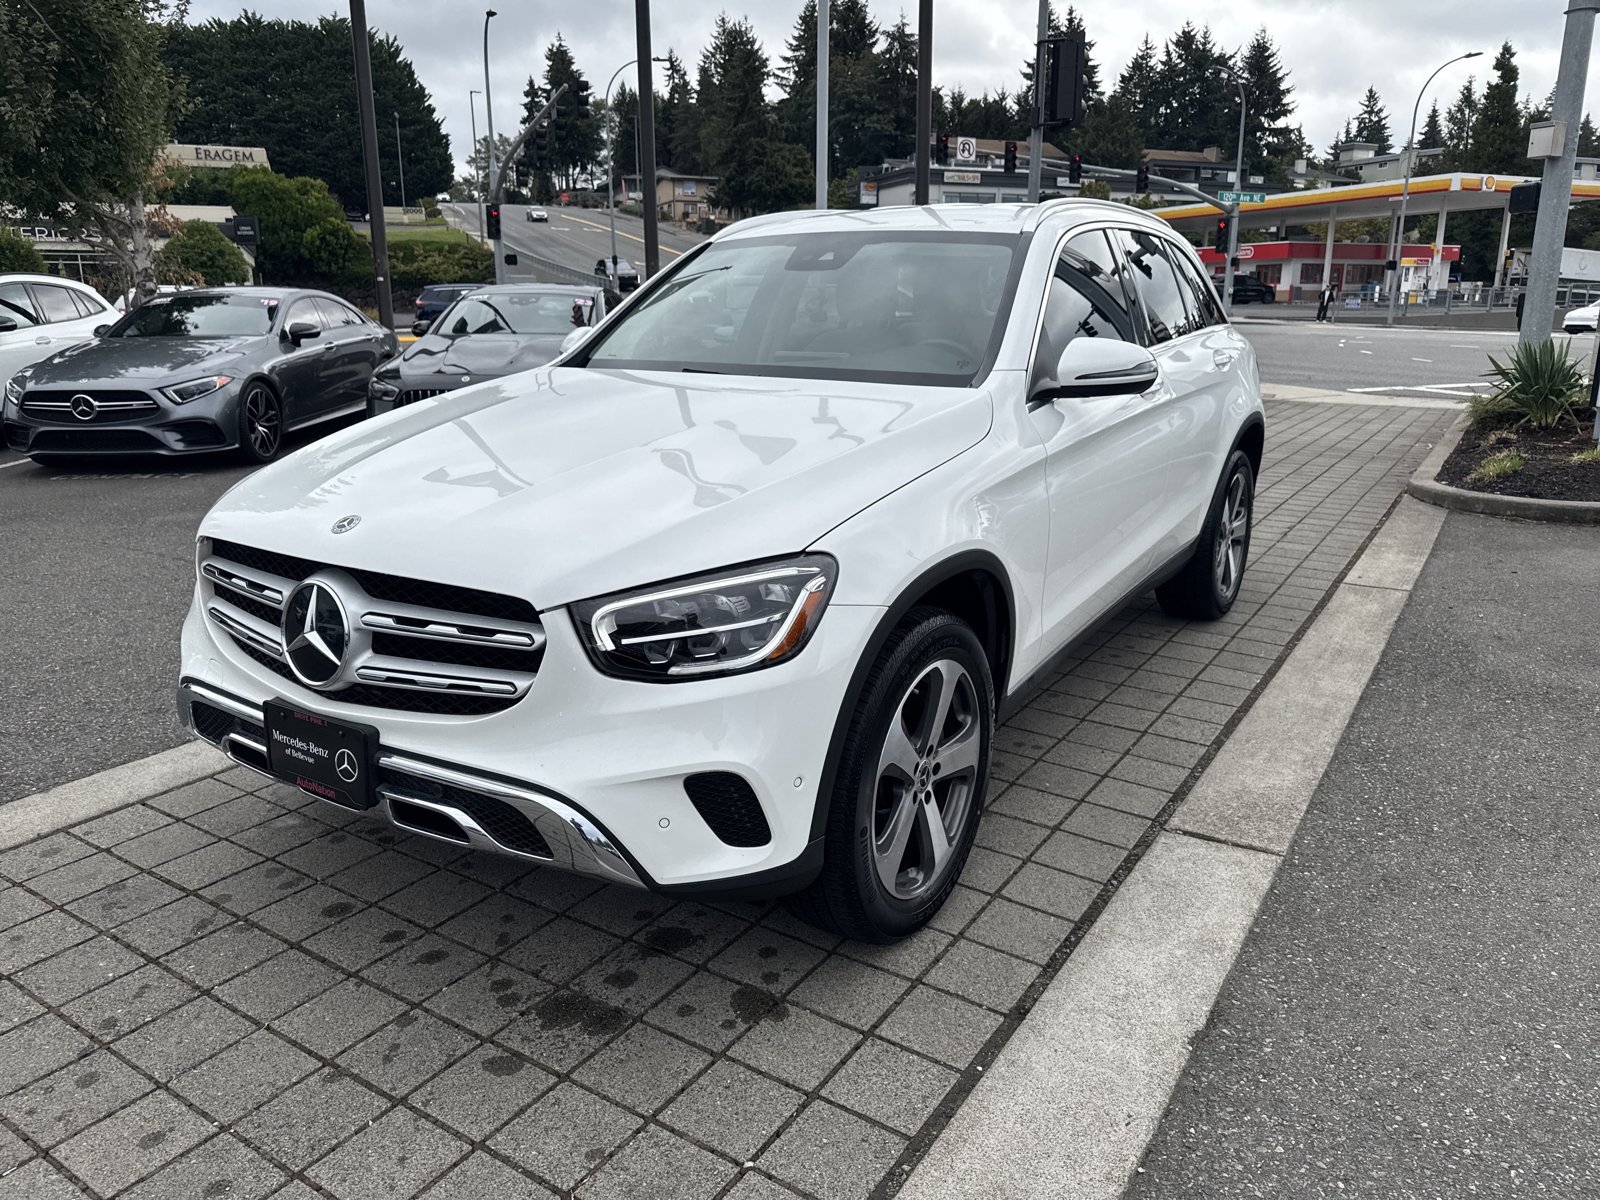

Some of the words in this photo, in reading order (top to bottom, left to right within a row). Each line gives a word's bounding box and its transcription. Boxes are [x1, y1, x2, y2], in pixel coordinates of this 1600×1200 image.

[1223, 192, 1237, 201] 120th
[1240, 193, 1250, 202] Ave
[1253, 194, 1261, 203] NE
[272, 729, 329, 758] Mercedes-Benz
[285, 747, 291, 756] of
[291, 748, 315, 764] Bellevue
[296, 776, 336, 799] AutoNation
